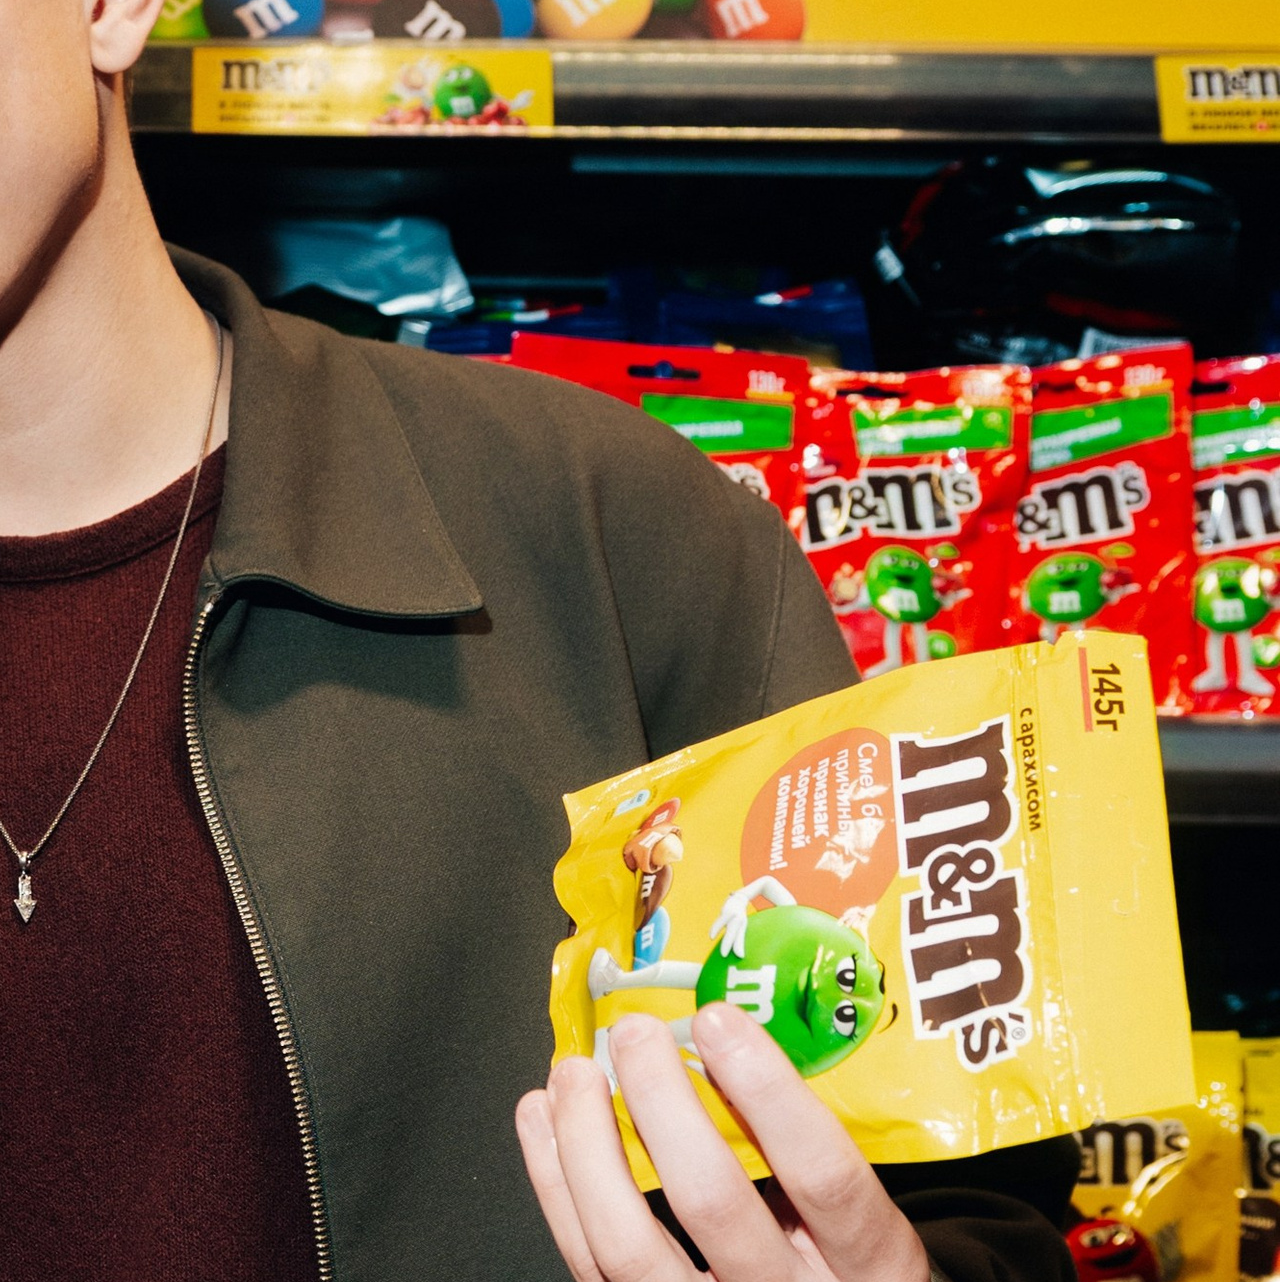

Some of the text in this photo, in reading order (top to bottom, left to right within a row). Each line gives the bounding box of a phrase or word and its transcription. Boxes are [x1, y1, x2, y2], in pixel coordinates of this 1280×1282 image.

[1091, 662, 1126, 732] 145г
[791, 766, 812, 850] хорошей
[812, 757, 830, 839] признак
[1016, 707, 1043, 833] с арахисом
[769, 775, 791, 871] компании!
